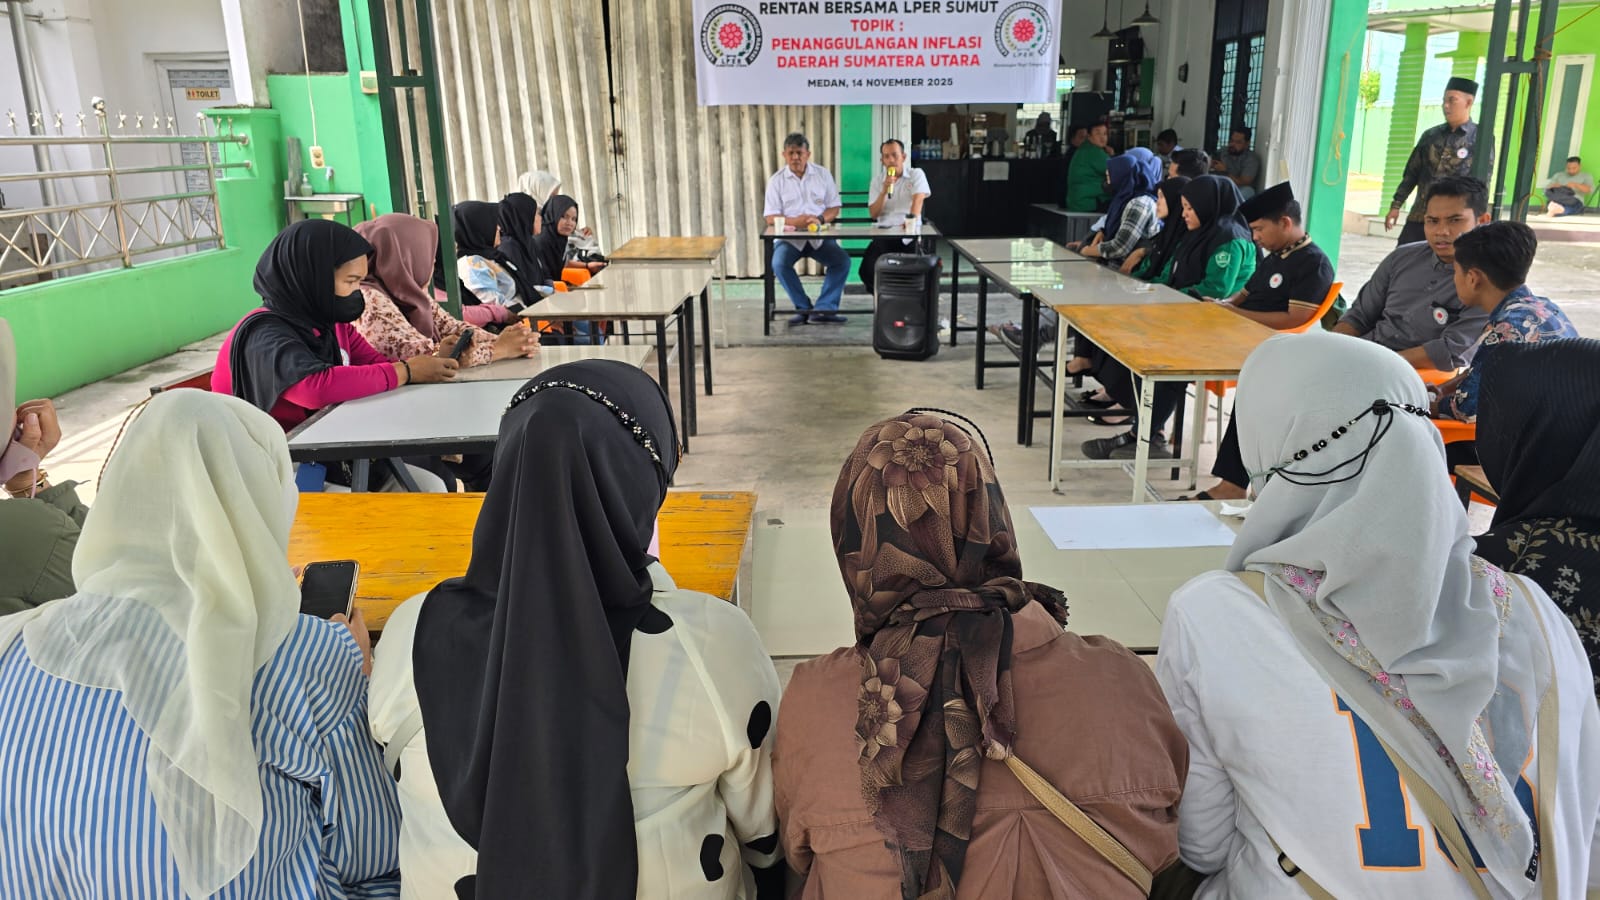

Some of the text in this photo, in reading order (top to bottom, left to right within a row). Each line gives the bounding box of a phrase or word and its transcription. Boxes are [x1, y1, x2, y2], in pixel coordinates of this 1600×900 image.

[760, 1, 998, 14] RENTAN BERSAMA LPER SUMUT
[850, 19, 894, 32] TOPIK
[771, 37, 982, 50] PENANGGULANGAN INFLASI
[777, 56, 839, 68] DAERAH
[844, 55, 925, 67] SUMATERA
[931, 54, 980, 67] UTARA
[807, 78, 953, 88] MEDAN, 14 NOVEMBER 2025
